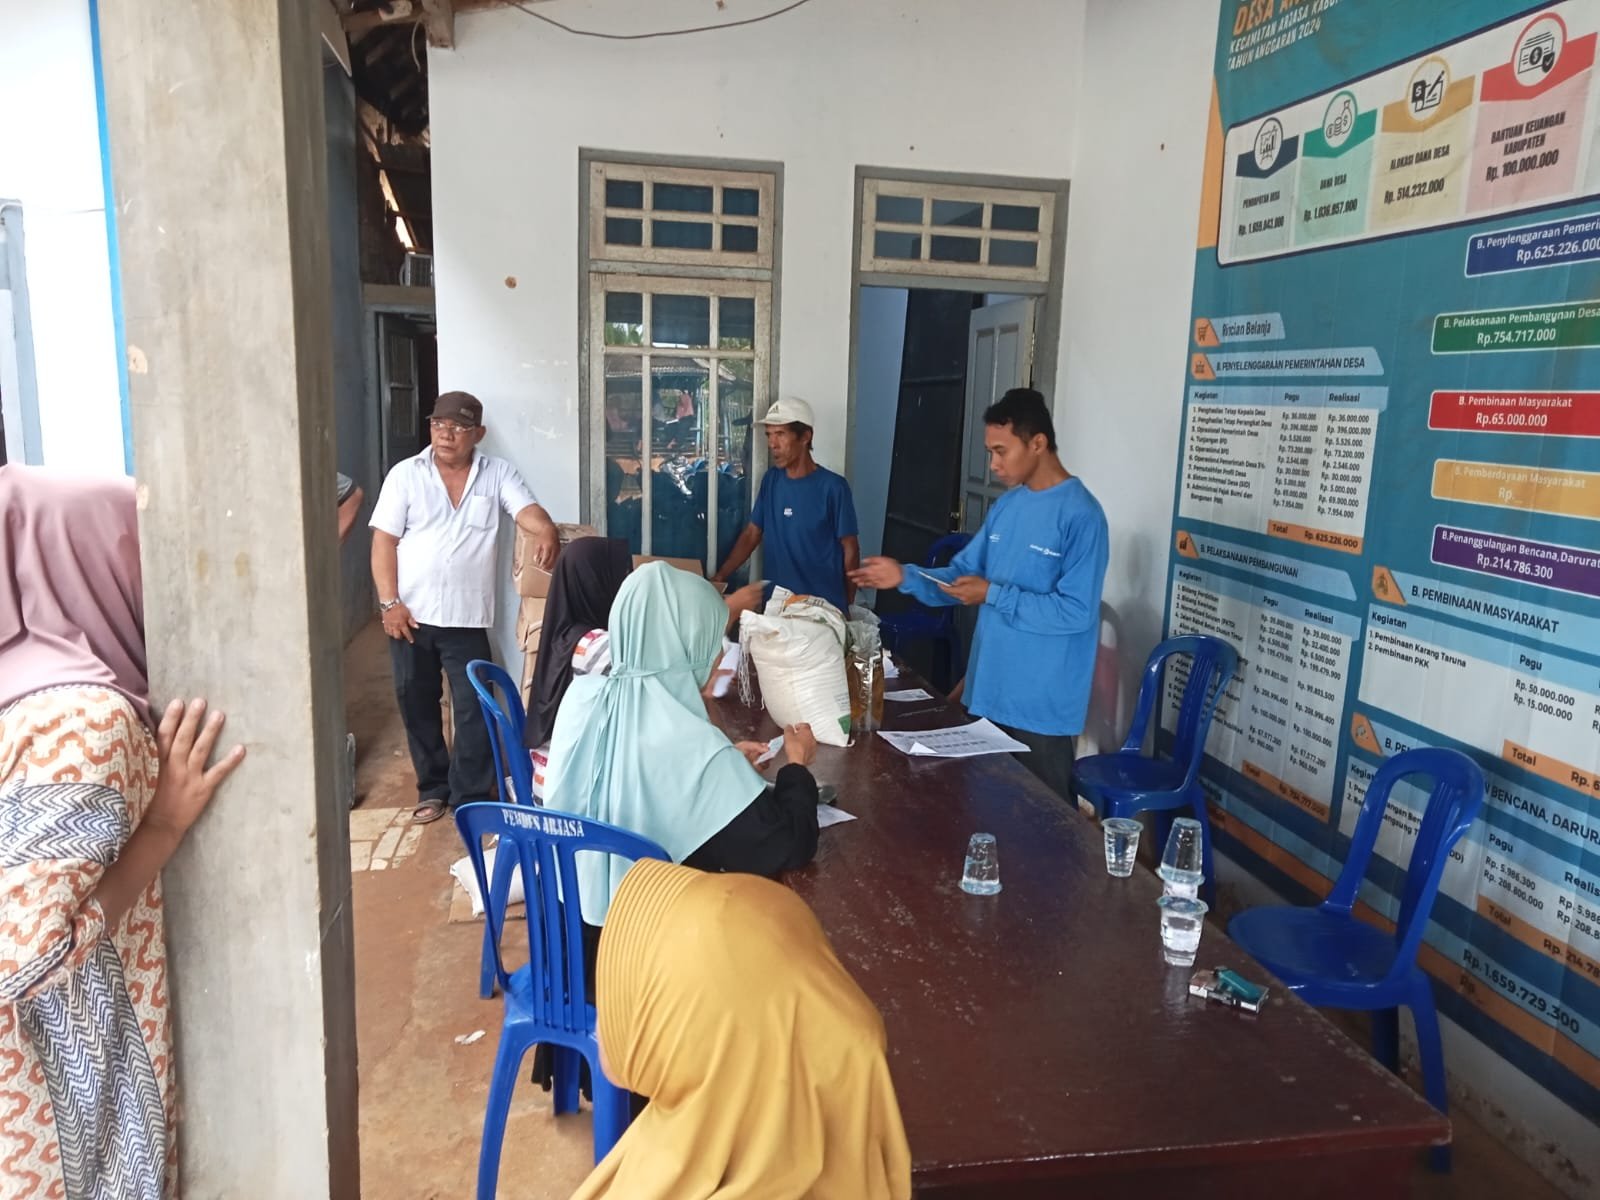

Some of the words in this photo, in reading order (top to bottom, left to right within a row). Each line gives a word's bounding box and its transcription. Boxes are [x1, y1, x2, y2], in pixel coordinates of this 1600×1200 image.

[1228, 52, 1252, 71] TAHUN
[1255, 29, 1296, 60] ANGGARAN
[1298, 18, 1321, 40] 2024
[1230, 21, 1277, 53] KECAMATAN
[1491, 125, 1523, 144] BANTUAN
[1525, 111, 1566, 134] KEUANGAN
[1415, 149, 1431, 163] DANA
[1433, 144, 1450, 159] DESA
[1504, 133, 1545, 156] KABUPATEN
[1486, 166, 1499, 182] Rp.
[1502, 149, 1559, 177] 100.000.000
[1384, 190, 1395, 205] Rp.
[1397, 178, 1444, 201] 514.232.000
[1477, 239, 1485, 249] B.
[1487, 226, 1561, 249] Penylenggaraan
[1222, 323, 1244, 337] Rincian
[1246, 320, 1271, 337] Belanja
[1444, 319, 1451, 328] B.
[1453, 313, 1506, 328] Pelaksanaan
[1477, 328, 1556, 347] Rp.754.717.000
[1222, 360, 1284, 371] PENYELENGGARAAN
[1284, 358, 1342, 369] PEMERINTAHAN
[1343, 357, 1365, 368] DESA
[1284, 392, 1299, 401] Pagu
[1329, 393, 1360, 402] Realisasi
[1459, 396, 1466, 405] B.
[1468, 396, 1516, 407] Pembinaan
[1518, 397, 1572, 409] Masyarakat
[1476, 412, 1548, 427] Rp.65.000.000
[1530, 473, 1585, 488] Masyarakat
[1272, 524, 1288, 534] Total
[1206, 545, 1249, 565] PELAKSANAAN
[1249, 556, 1299, 578] PEMBANGUNAN
[1477, 553, 1553, 580] Rp.214.786.300
[1305, 608, 1334, 625] Realisasi
[1412, 585, 1420, 597] B.
[1422, 587, 1481, 613] PEMBINAAN
[1483, 603, 1559, 633] MASYARAKAT
[1372, 612, 1407, 629] Kegiatan
[1519, 654, 1542, 671] Pagu
[1375, 632, 1413, 649] Pembinaan
[1415, 645, 1439, 660] Karang
[1441, 652, 1466, 667] Taruna
[1375, 645, 1413, 663] Pembinaan
[1414, 657, 1429, 669] PKK
[1515, 679, 1527, 691] Rp.
[1529, 683, 1575, 706] 50.000.000
[1513, 693, 1525, 706] Rp.
[1527, 698, 1573, 721] 15.000.000
[1385, 738, 1392, 751] B.
[1512, 748, 1536, 766] Total
[1571, 771, 1589, 788] Rp.
[1491, 786, 1549, 824] BENCANA,
[1489, 833, 1513, 853] Pagu
[1486, 856, 1498, 869] Rp.
[1500, 864, 1536, 890] 5.986.300
[1559, 896, 1576, 911] Rp.
[1484, 870, 1496, 883] Rp.
[1498, 878, 1543, 909] 208.800.000
[1557, 910, 1573, 926] Rp.
[1488, 905, 1511, 926] Total
[1543, 939, 1562, 956] Rp.
[1463, 949, 1579, 1034] Rp.1.659.729.300
